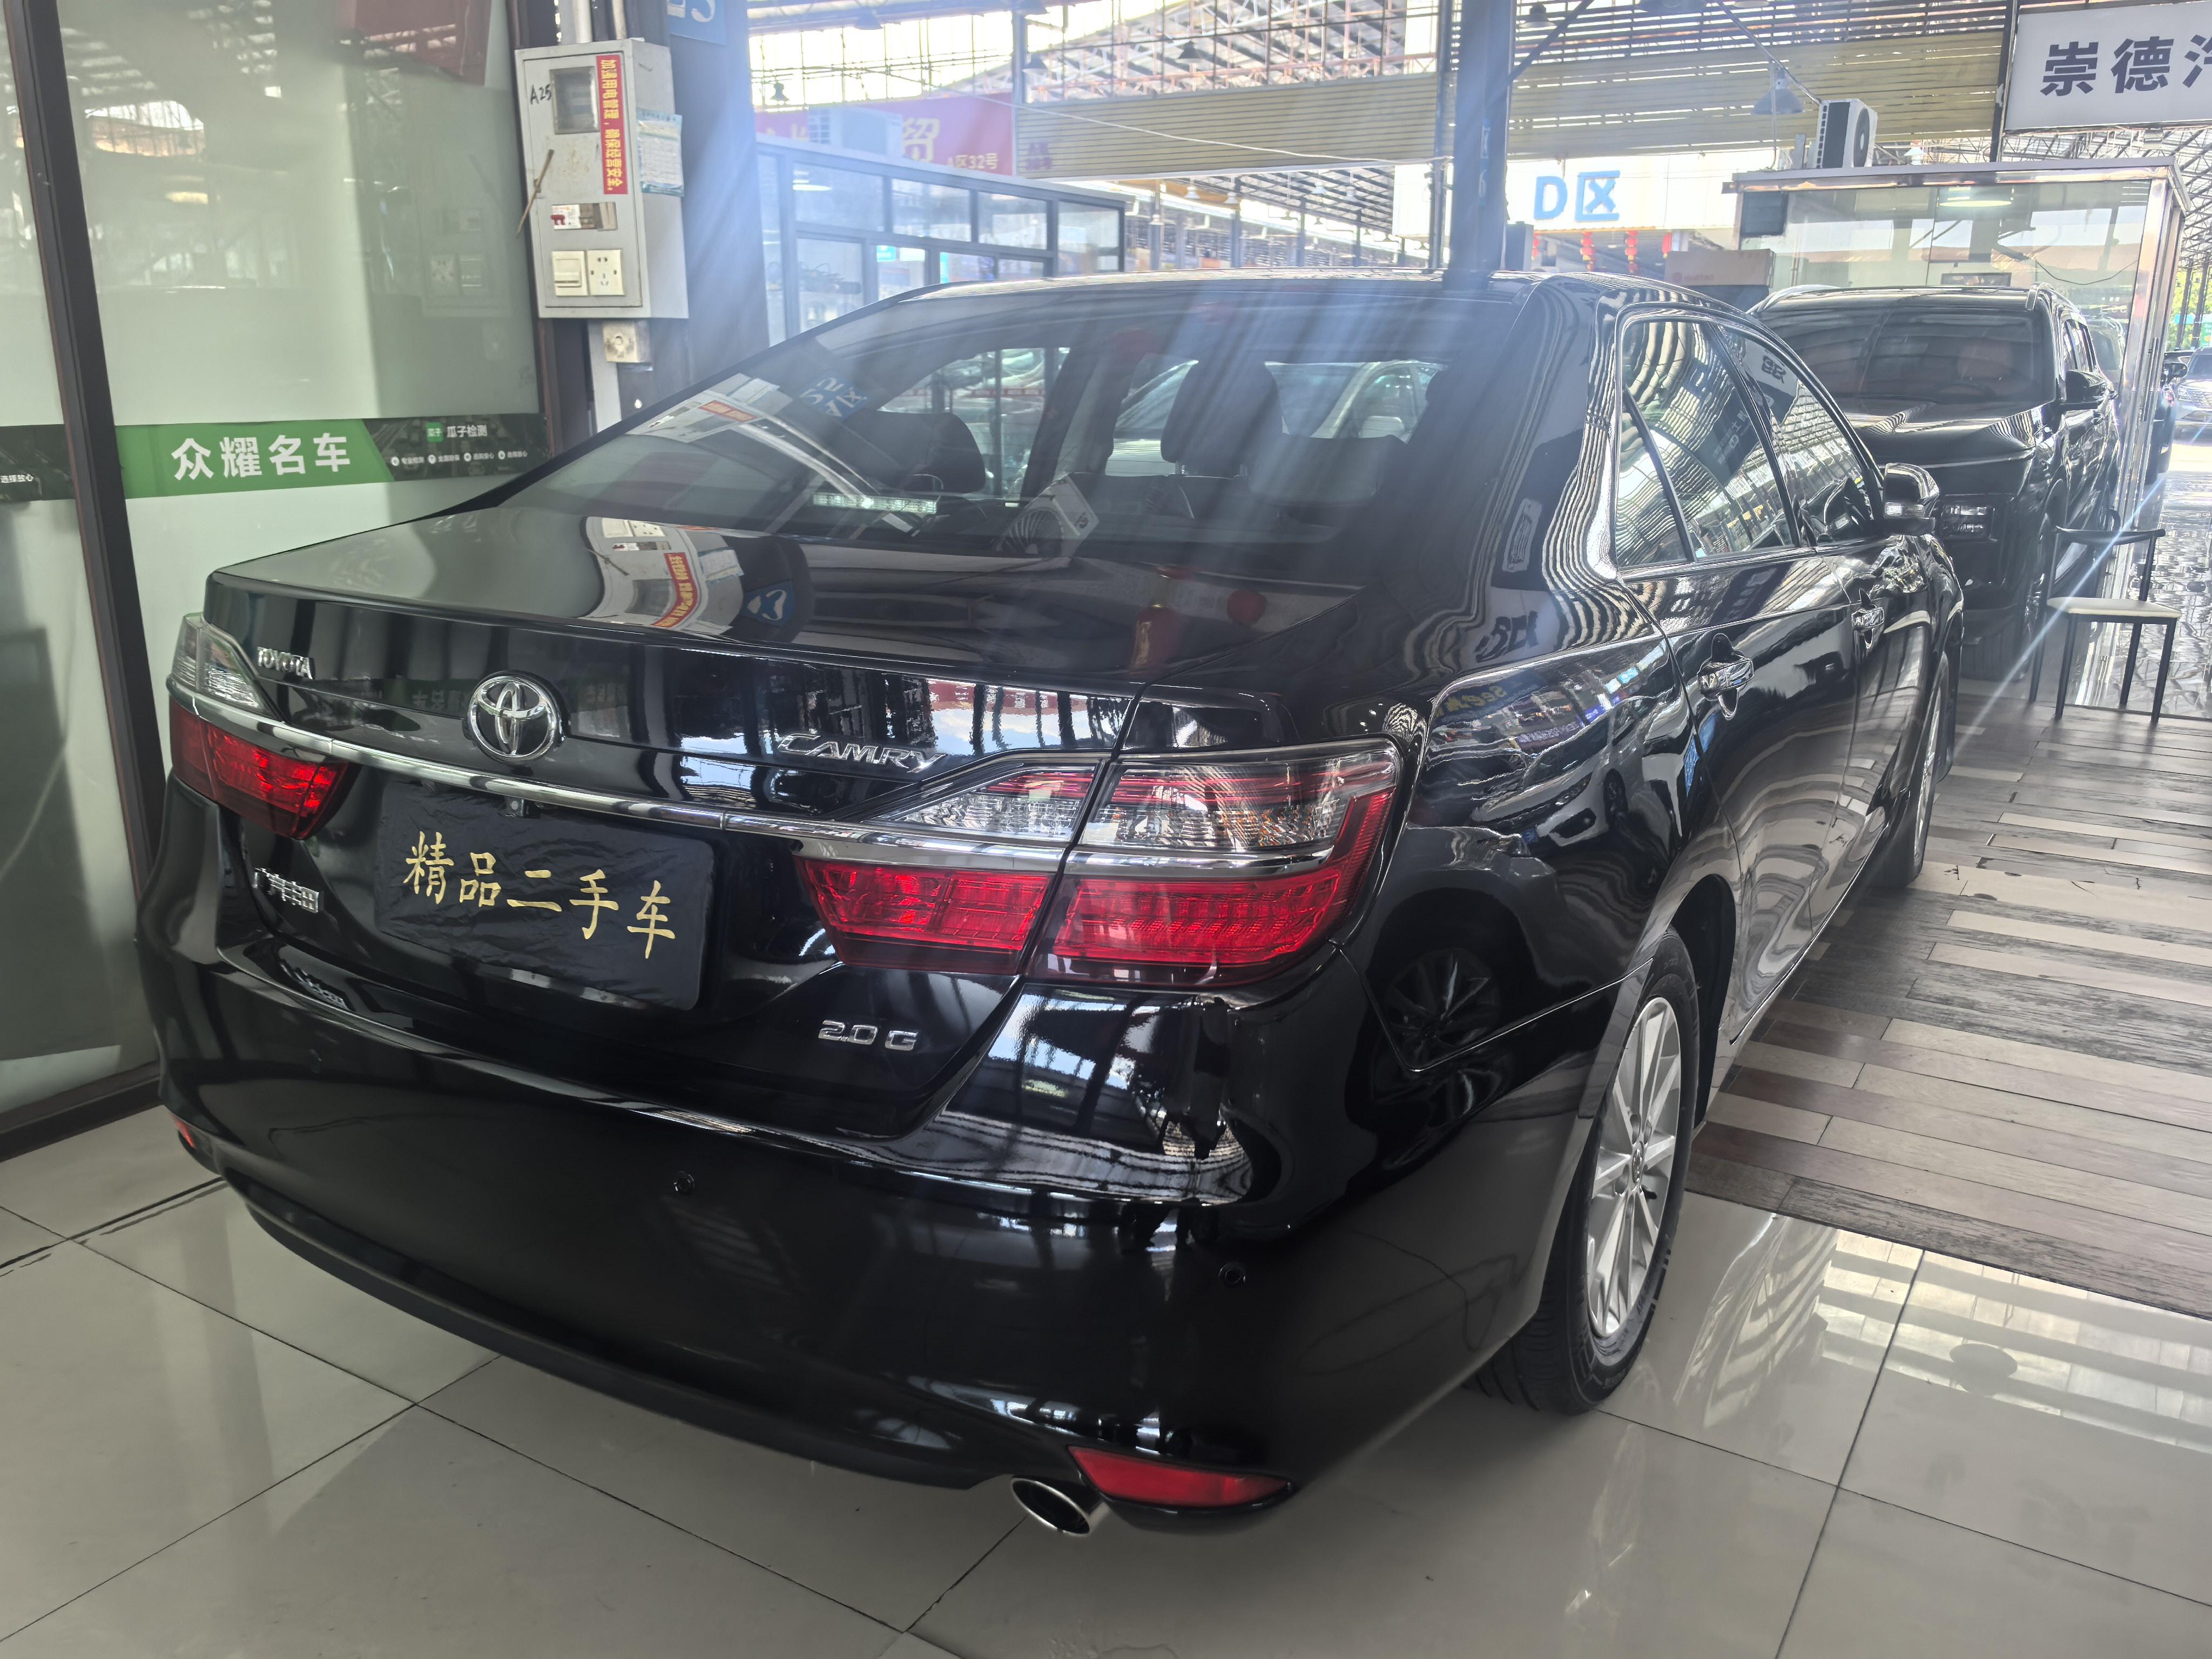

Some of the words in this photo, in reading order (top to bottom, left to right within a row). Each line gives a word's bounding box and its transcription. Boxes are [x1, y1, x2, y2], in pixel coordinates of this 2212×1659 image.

[530, 84, 551, 105] A25
[1534, 170, 1621, 222] D区
[446, 424, 488, 438] 瓜子检测
[171, 433, 350, 481] 众耀名车
[257, 646, 313, 679] TOYOTA
[777, 733, 947, 773] CAMRY
[403, 831, 676, 959] 精品二手车
